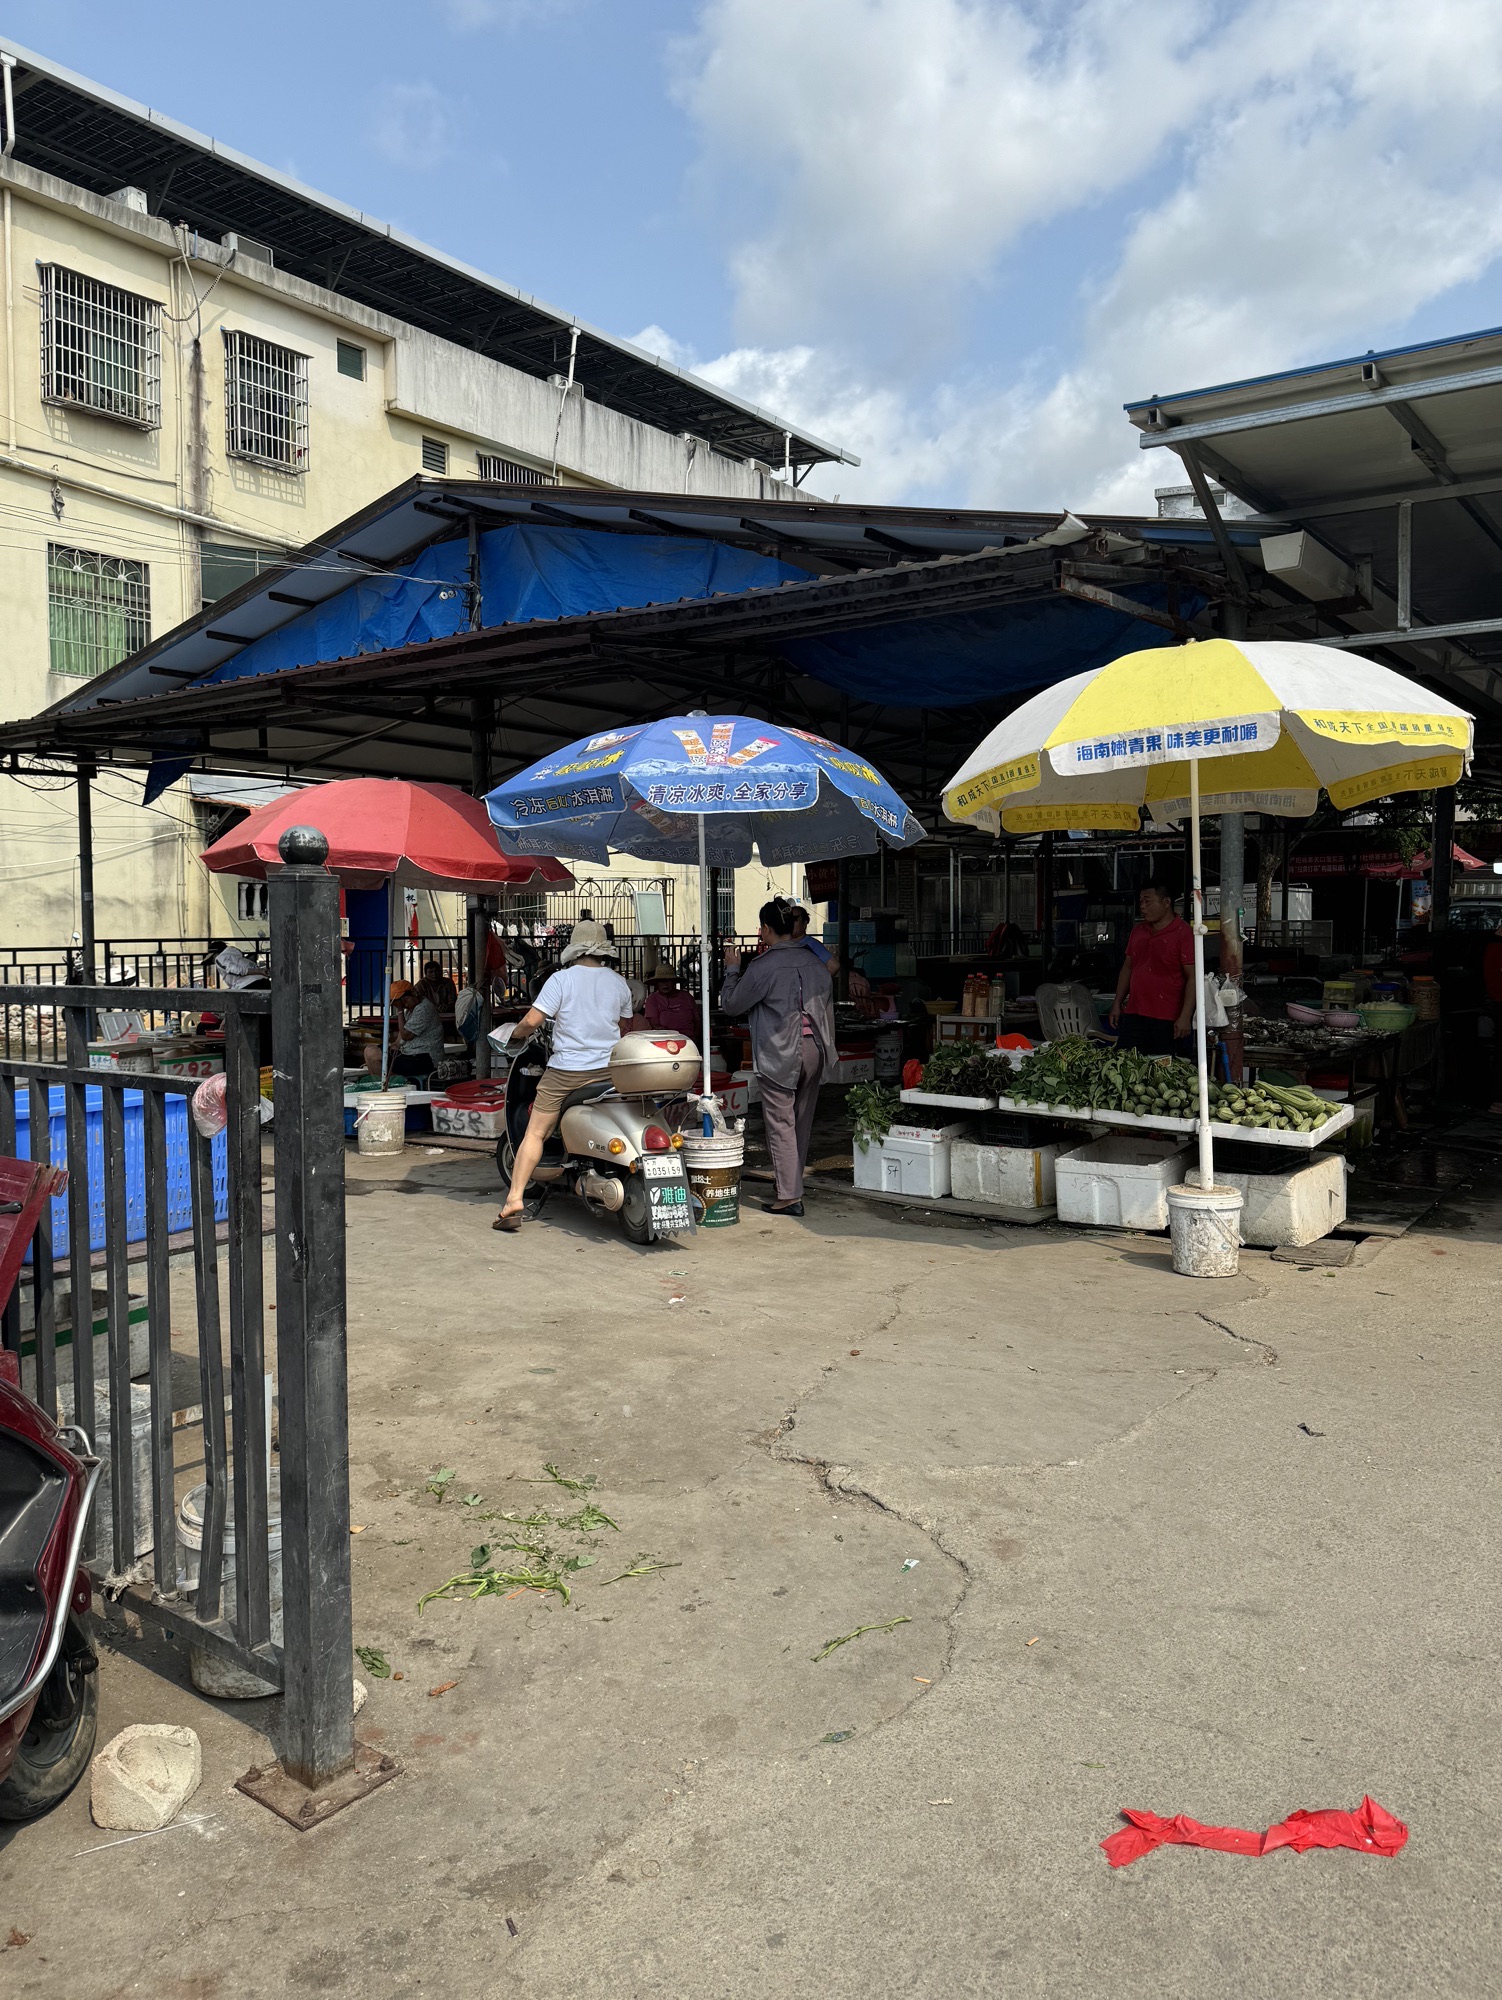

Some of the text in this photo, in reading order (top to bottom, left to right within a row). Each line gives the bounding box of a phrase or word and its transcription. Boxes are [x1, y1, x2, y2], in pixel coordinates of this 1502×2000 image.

[1076, 722, 1258, 761] 海南嫩青果 味美更耐嚼
[652, 1166, 681, 1177] 035159
[661, 1186, 688, 1204] 雅迪
